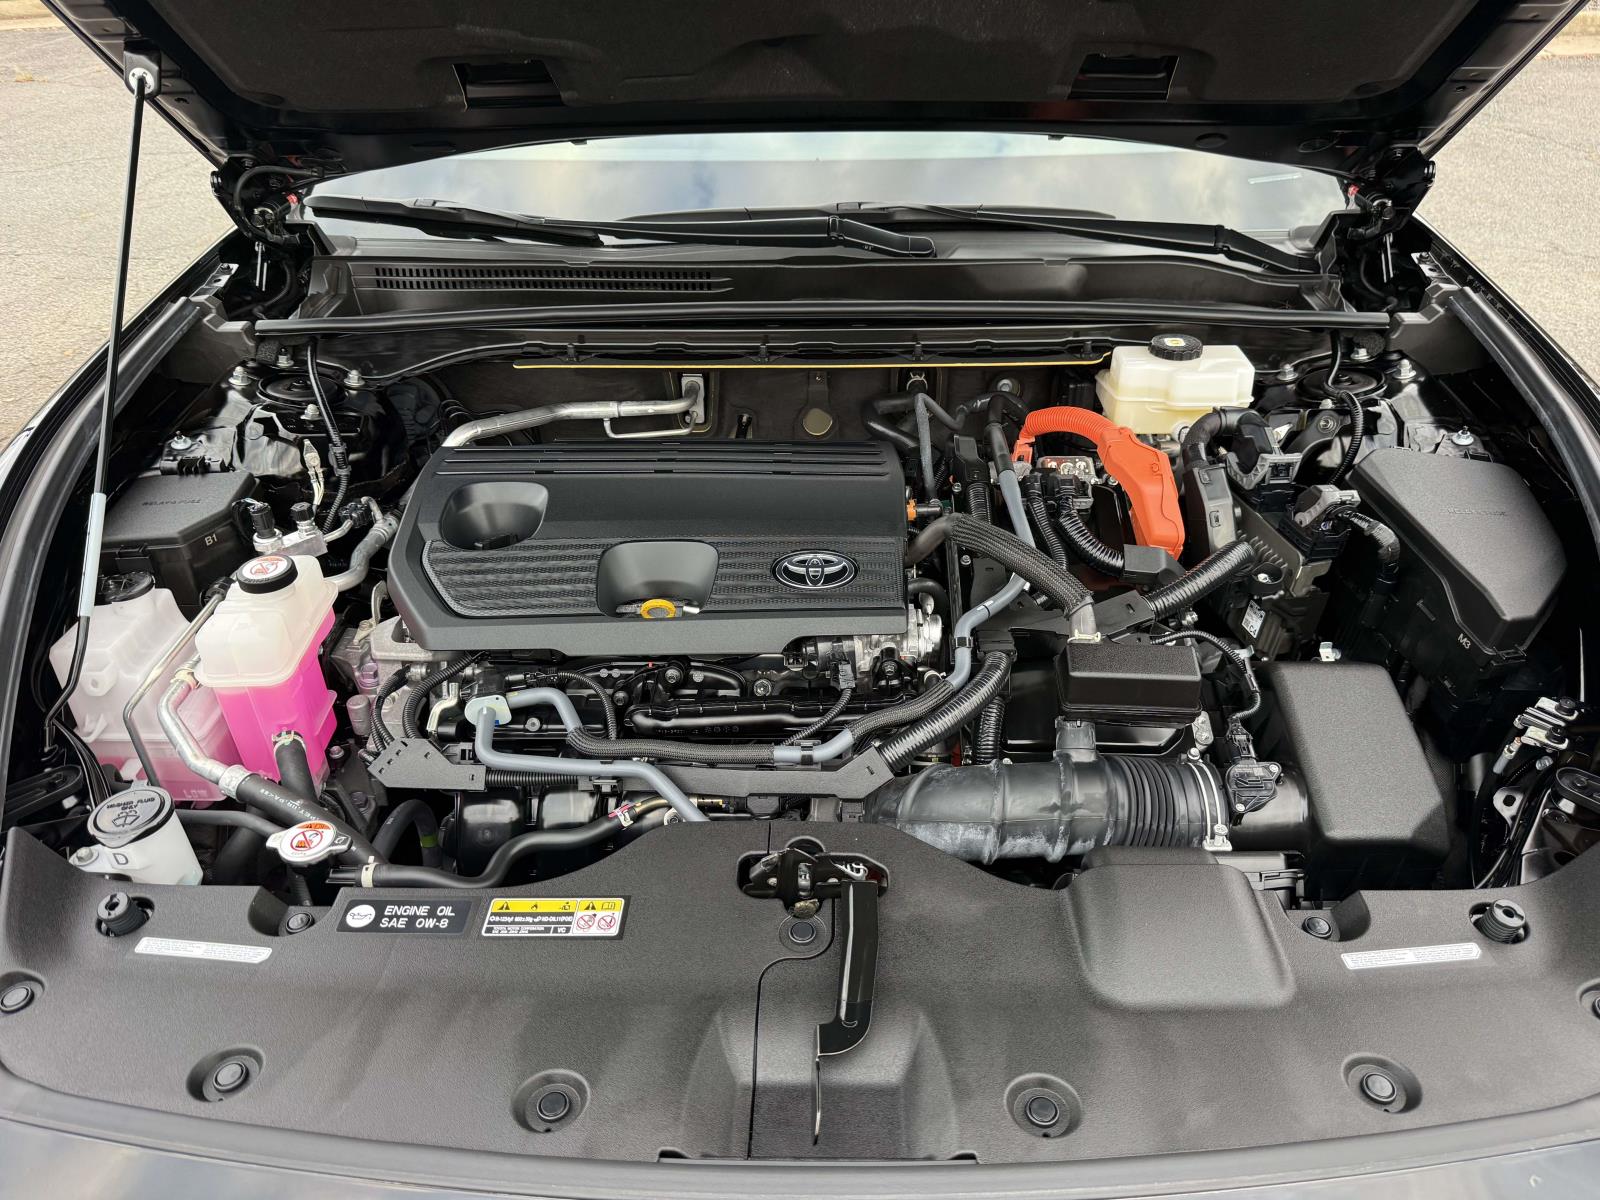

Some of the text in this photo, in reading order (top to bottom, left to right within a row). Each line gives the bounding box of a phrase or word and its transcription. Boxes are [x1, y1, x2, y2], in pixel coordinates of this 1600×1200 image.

[204, 533, 218, 546] B1
[1457, 633, 1471, 649] M3
[384, 905, 456, 917] ENGINE OIL
[379, 917, 449, 928] SAE 0W-8
